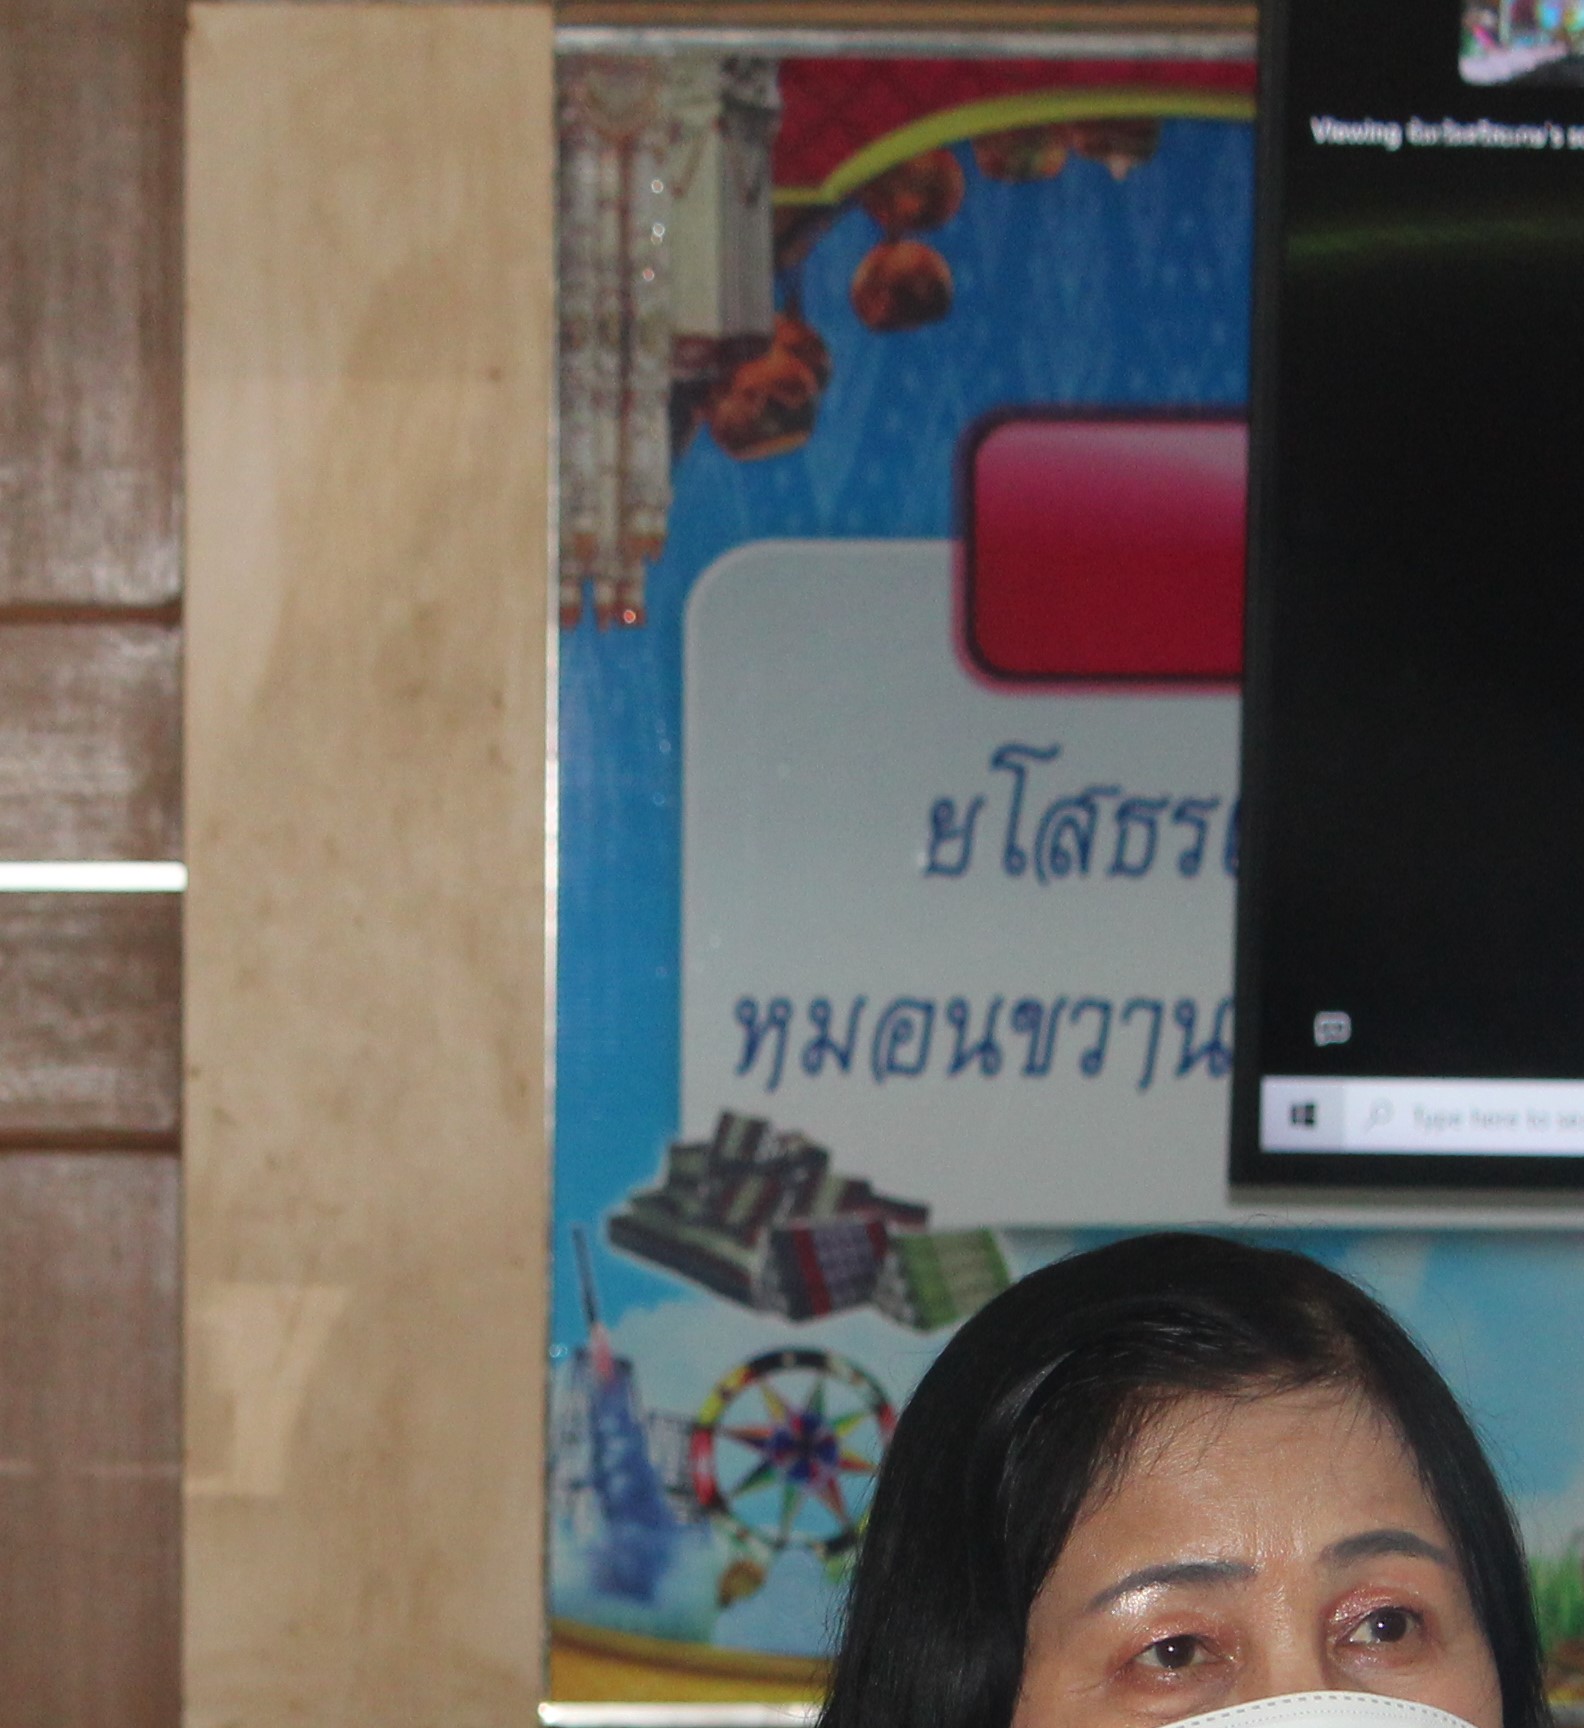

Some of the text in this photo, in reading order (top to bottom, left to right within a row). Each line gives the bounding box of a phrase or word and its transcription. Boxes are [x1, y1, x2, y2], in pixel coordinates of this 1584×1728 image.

[1310, 115, 1402, 151] Viewing
[1412, 1102, 1461, 1133] Type
[1469, 1104, 1519, 1130] here
[1526, 1104, 1551, 1131] to
